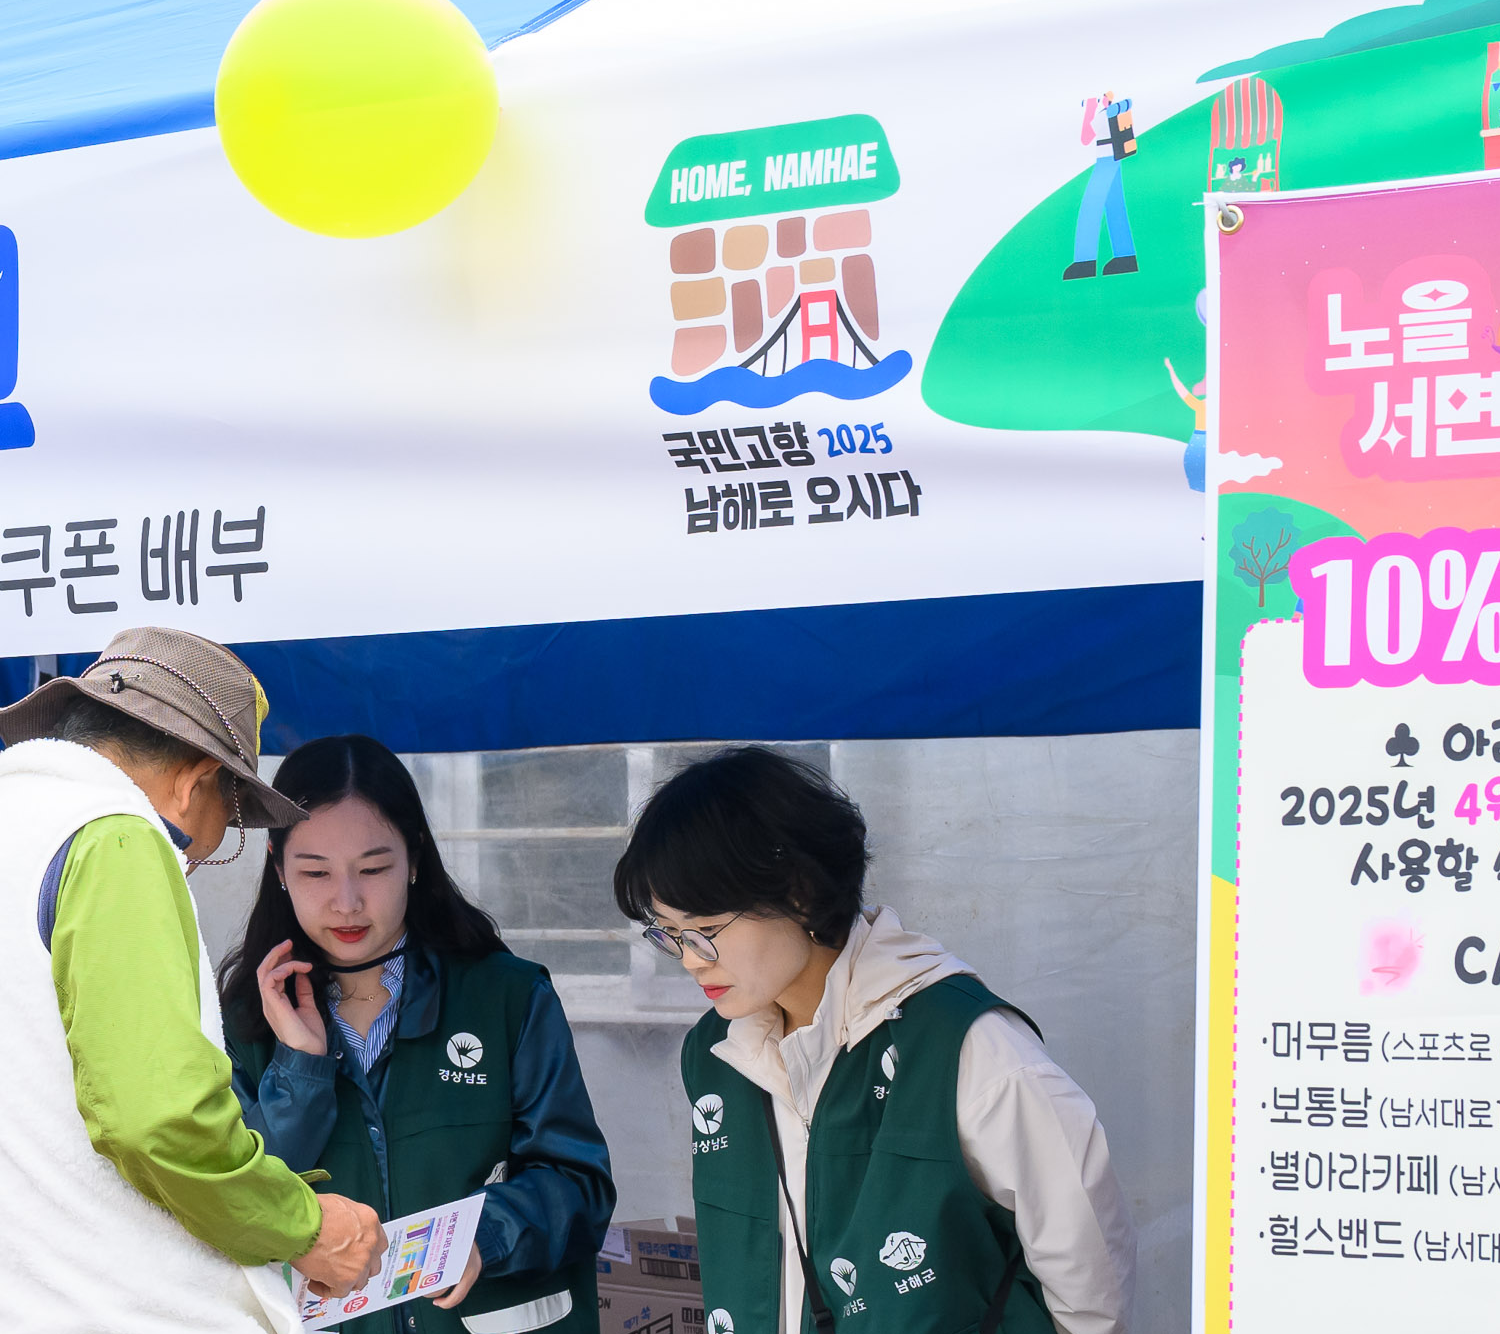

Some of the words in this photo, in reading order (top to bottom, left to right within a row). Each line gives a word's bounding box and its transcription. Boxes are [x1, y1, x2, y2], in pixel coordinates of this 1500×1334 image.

[670, 160, 752, 204] HOME,
[764, 142, 877, 192] NAMHAE
[1324, 279, 1472, 371] 노을
[662, 421, 815, 474] 국민고향
[818, 422, 893, 458] 2025
[685, 480, 794, 534] 남해로
[807, 470, 922, 524] 오시다
[140, 505, 269, 608] 배부
[1281, 782, 1435, 828] 2025년
[1350, 838, 1478, 895] 사용할
[1381, 1031, 1493, 1063] (스포츠로
[438, 1067, 488, 1086] 경상남도
[894, 1267, 937, 1295] 남해군
